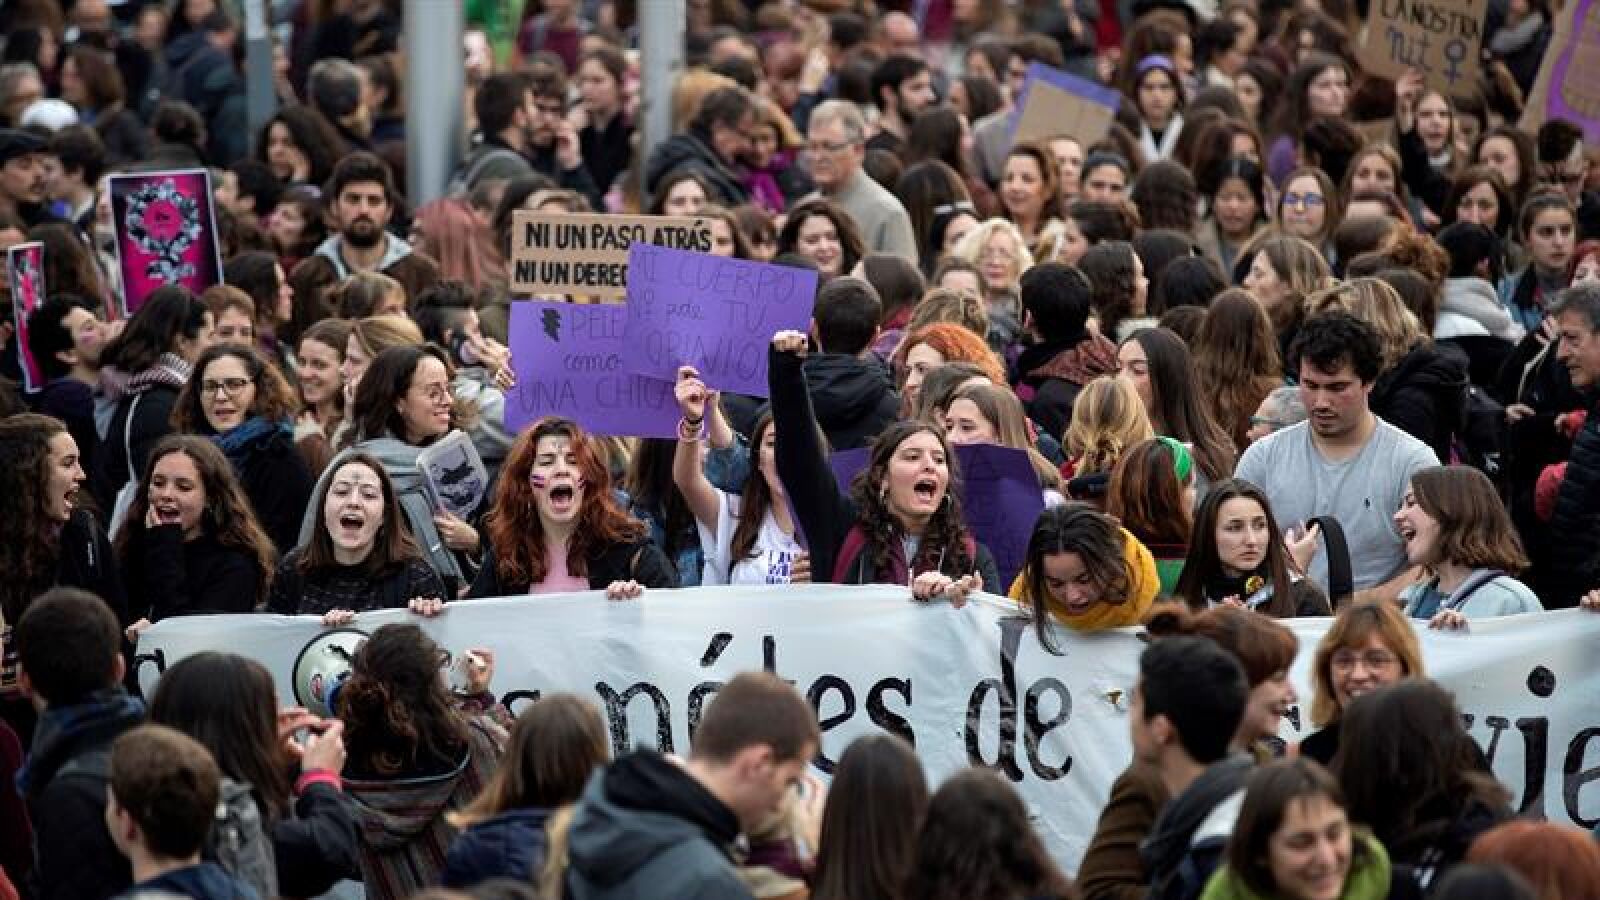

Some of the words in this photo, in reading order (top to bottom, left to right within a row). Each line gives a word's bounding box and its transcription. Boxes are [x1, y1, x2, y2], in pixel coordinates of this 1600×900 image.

[525, 221, 548, 249] NI
[555, 223, 586, 249] UN
[591, 223, 646, 250] PASO
[653, 219, 711, 252] ATRÁS
[515, 259, 537, 283] NI
[541, 261, 569, 285] UN
[573, 262, 628, 287] DEREC
[570, 306, 627, 340] PELE
[519, 378, 578, 413] UNA
[964, 617, 1073, 783] de
